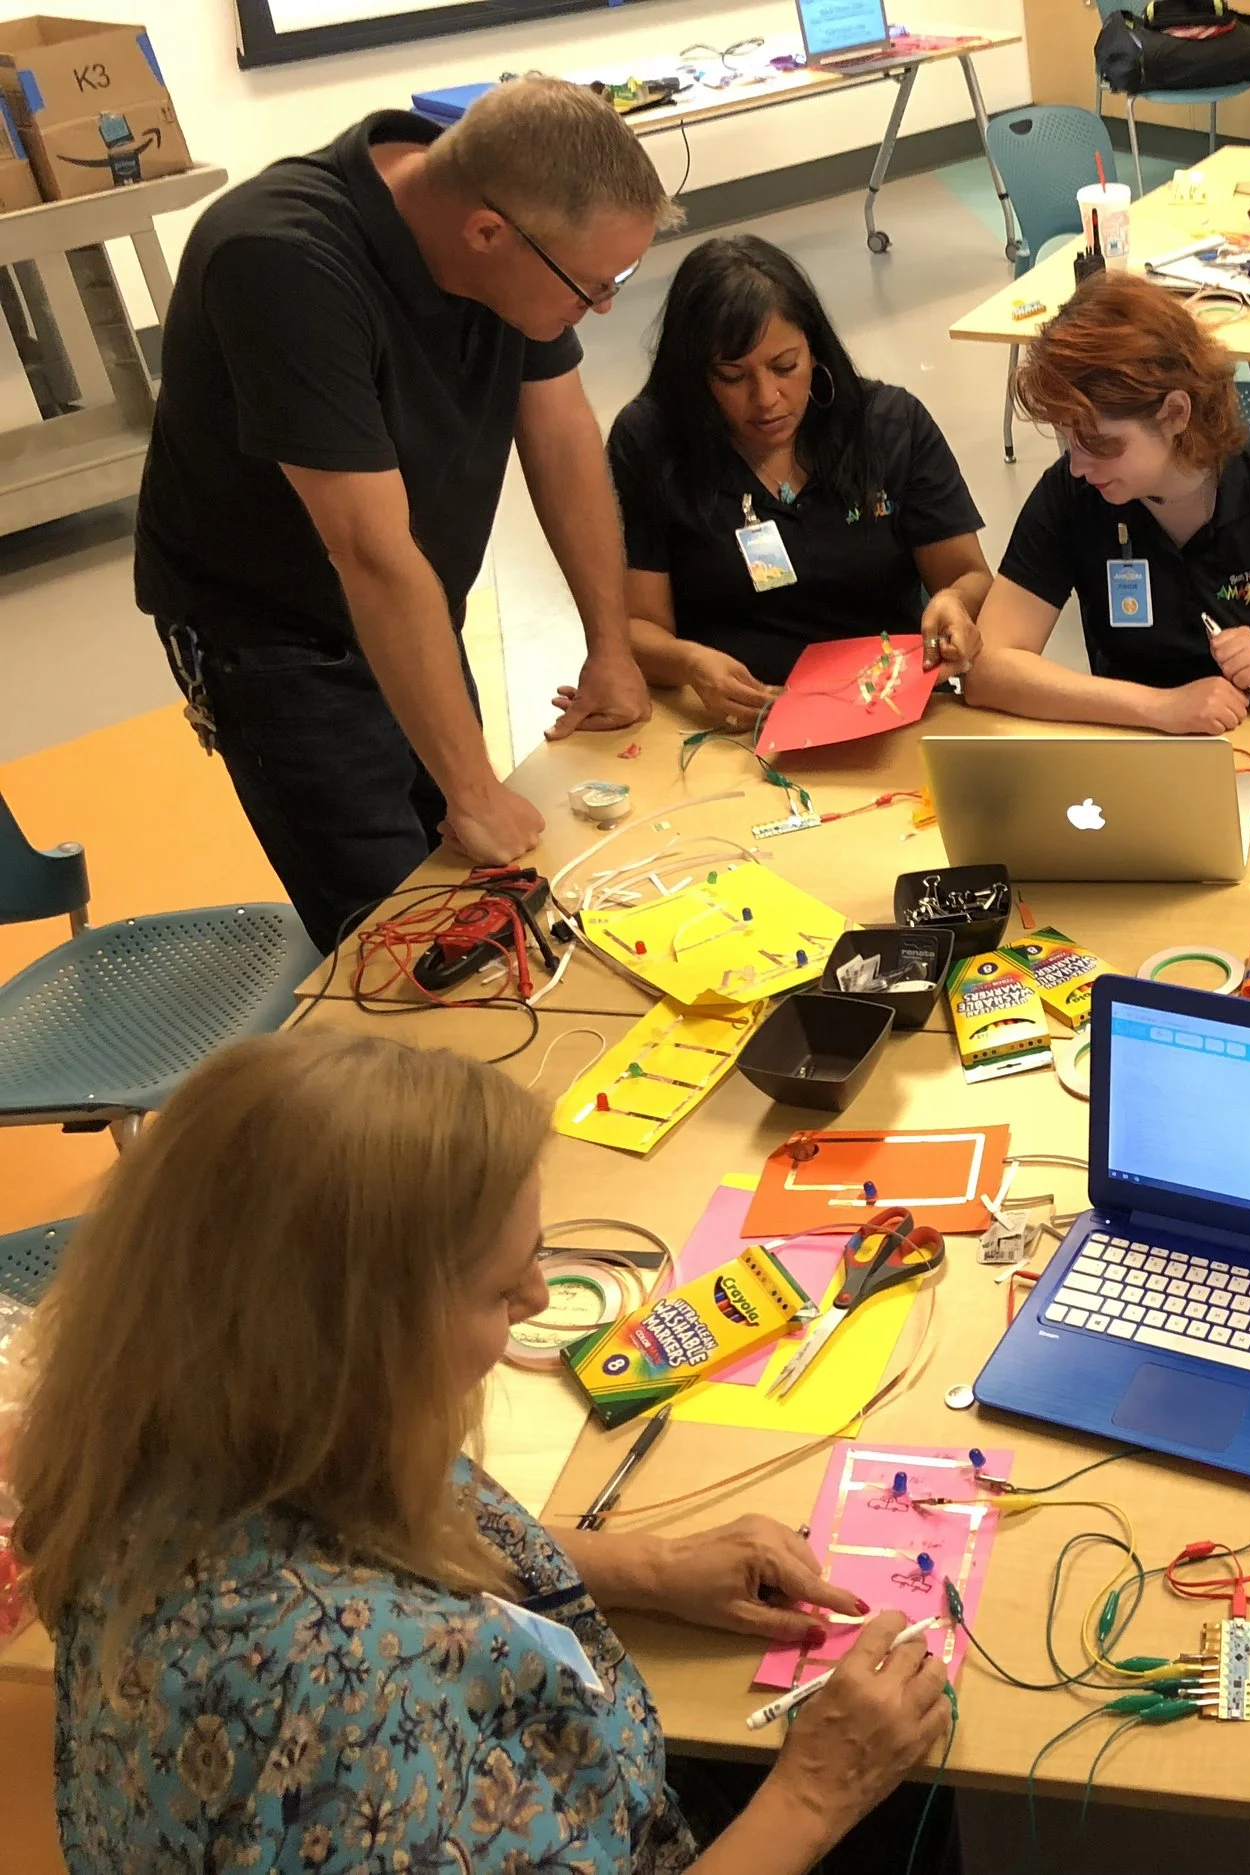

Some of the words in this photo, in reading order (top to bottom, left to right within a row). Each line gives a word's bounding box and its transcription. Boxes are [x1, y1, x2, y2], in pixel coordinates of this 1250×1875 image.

[73, 63, 111, 93] K3
[1036, 955, 1098, 986] WASHABL
[957, 988, 1035, 1013] WASHABLE
[963, 982, 1024, 1000] MARKERS
[722, 1276, 760, 1324] Crayola
[652, 1299, 708, 1366] WASHABLE
[674, 1299, 718, 1350] ULTRA-CLEAN
[640, 1315, 688, 1367] MARKERS
[607, 1357, 626, 1372] 8
